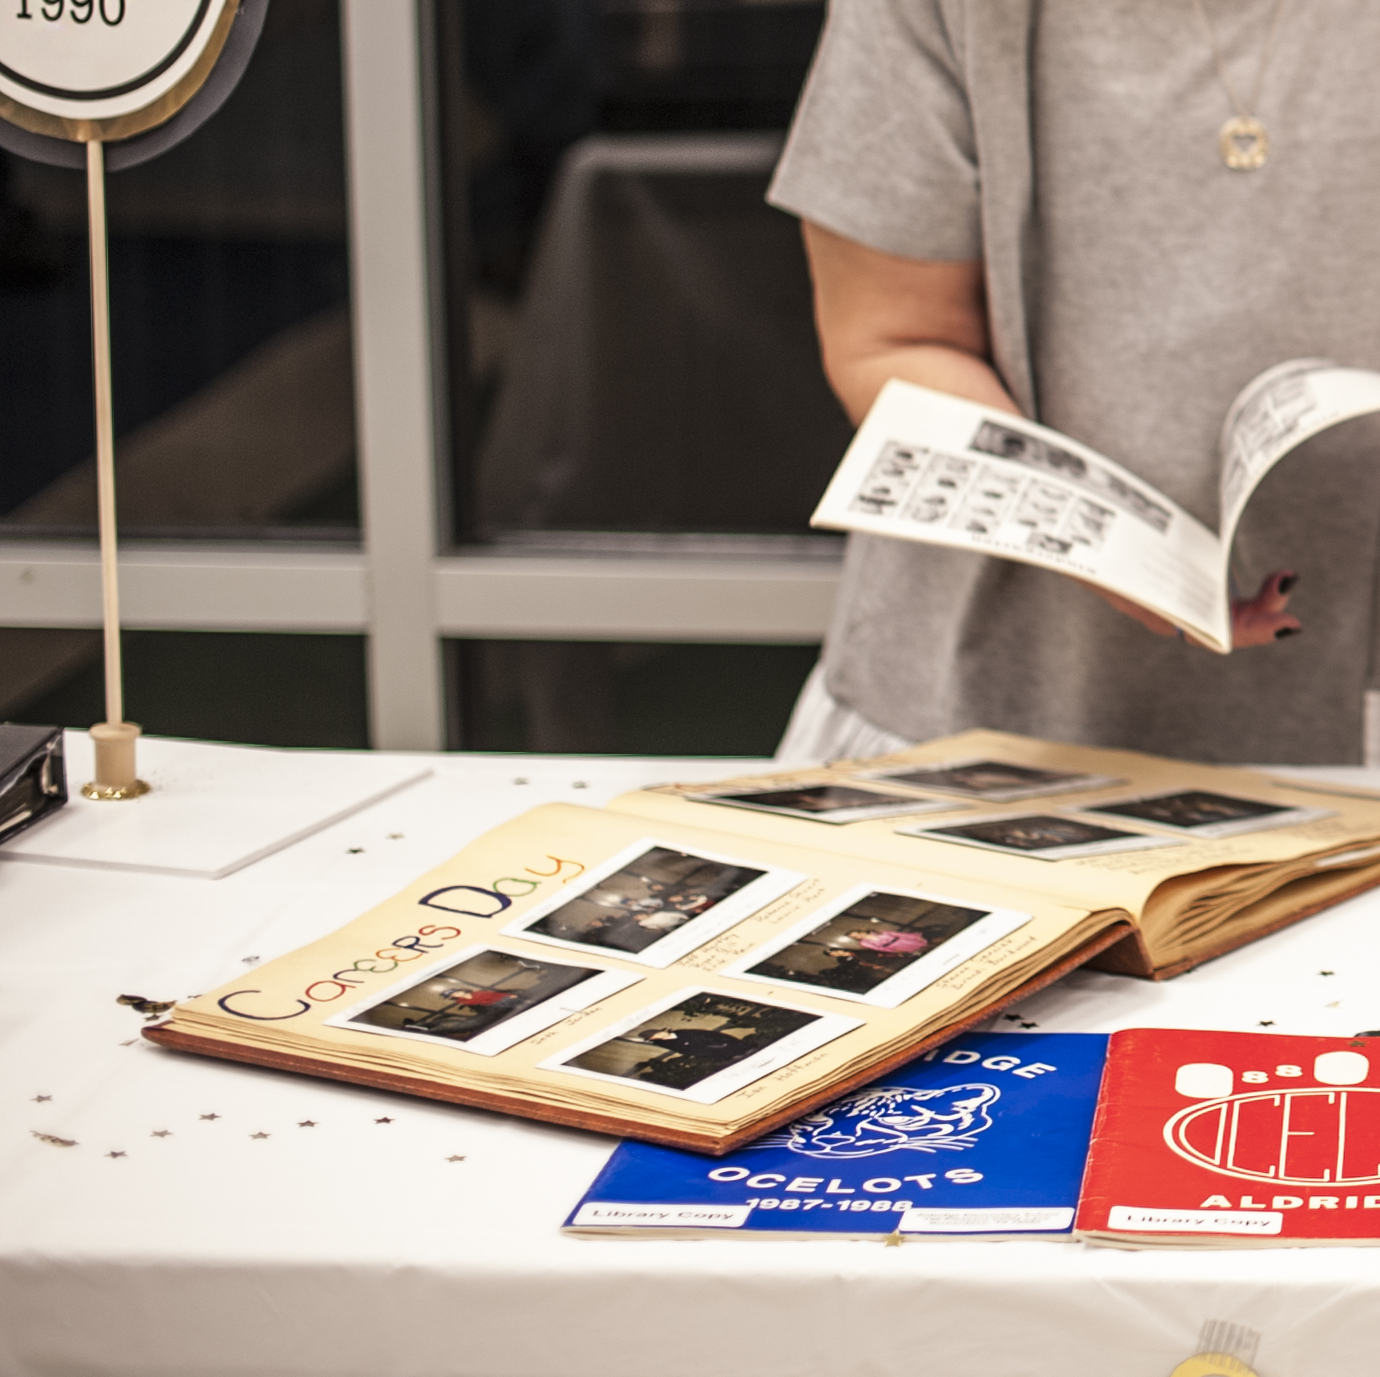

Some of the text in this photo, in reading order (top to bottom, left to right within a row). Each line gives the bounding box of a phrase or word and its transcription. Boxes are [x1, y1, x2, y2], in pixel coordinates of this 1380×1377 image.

[418, 855, 585, 918] Day
[923, 1049, 1057, 1079] IDGE
[708, 1166, 984, 1195] OCELOTS
[593, 1210, 733, 1220] Library Copy
[745, 1198, 913, 1212] 1987-1988
[1127, 1215, 1270, 1226] Library Copy
